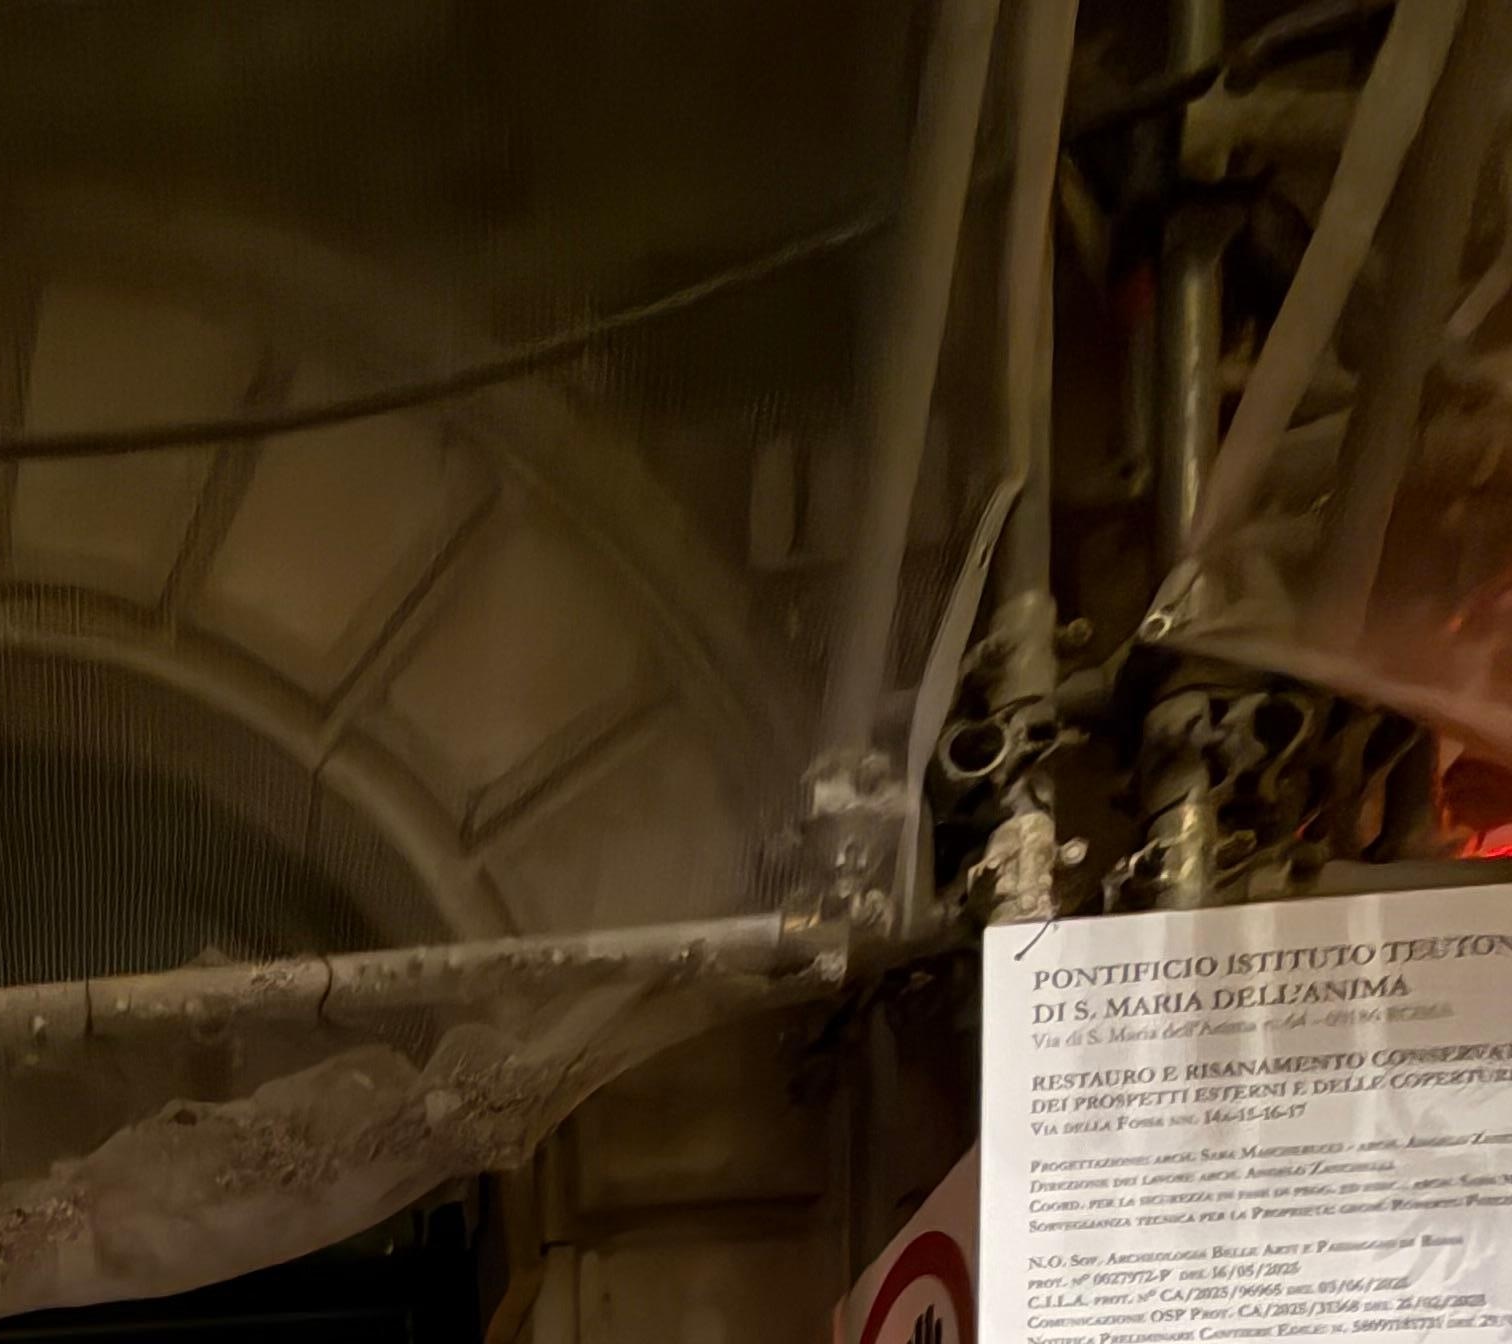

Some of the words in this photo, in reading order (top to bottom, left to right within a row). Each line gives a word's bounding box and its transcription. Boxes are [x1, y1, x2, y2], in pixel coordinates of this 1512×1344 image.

[1032, 957, 1218, 991] PONTIFICIO
[1221, 944, 1376, 978] ISTITUTO
[1032, 1002, 1065, 1025] DI
[1074, 1001, 1097, 1021] S.
[1105, 991, 1203, 1020] MARIA
[1211, 974, 1413, 1010] DELL'ANIMA
[1031, 1066, 1156, 1091] RESTAURO
[1161, 1066, 1178, 1082] E
[1185, 1052, 1366, 1081] RISANAMENTO
[1030, 1100, 1069, 1115] DEI
[1073, 1089, 1189, 1112] PROSPETTI
[1193, 1081, 1287, 1103] ESTERNI
[1312, 1076, 1385, 1095] DELLE
[1150, 1308, 1187, 1323] OSP
